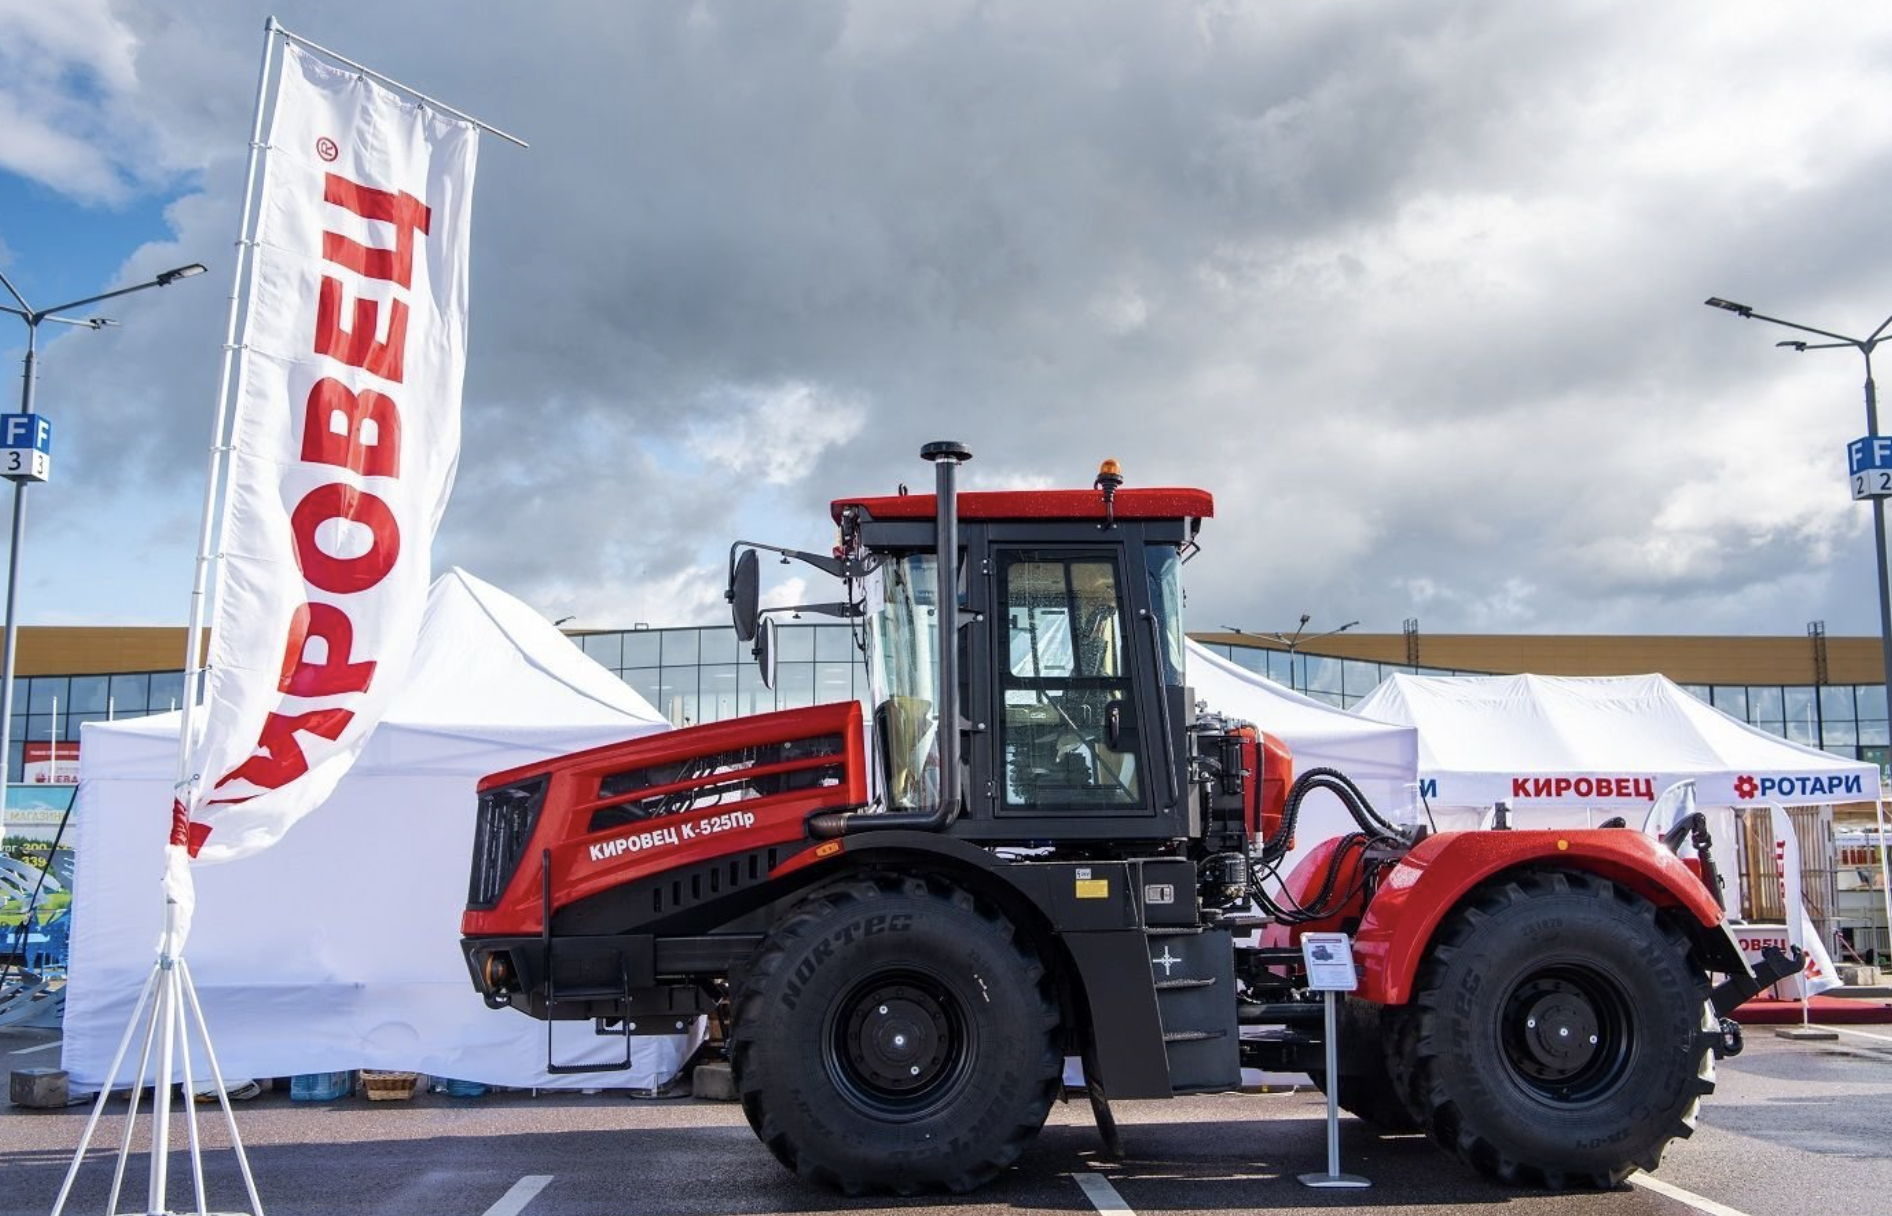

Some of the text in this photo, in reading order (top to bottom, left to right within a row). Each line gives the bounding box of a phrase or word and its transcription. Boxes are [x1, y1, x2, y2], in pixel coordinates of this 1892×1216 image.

[7, 417, 28, 445] F
[37, 420, 49, 448] F
[8, 451, 21, 471] 3
[37, 454, 44, 475] 3
[1851, 442, 1863, 471] F
[1872, 440, 1892, 466] F
[1856, 475, 1864, 495] 2
[1879, 472, 1892, 490] 2
[1512, 778, 1654, 801] КИРОВЕЦ
[1760, 774, 1862, 797] РОТАРИ
[588, 826, 679, 862] КИРОВЕЦ
